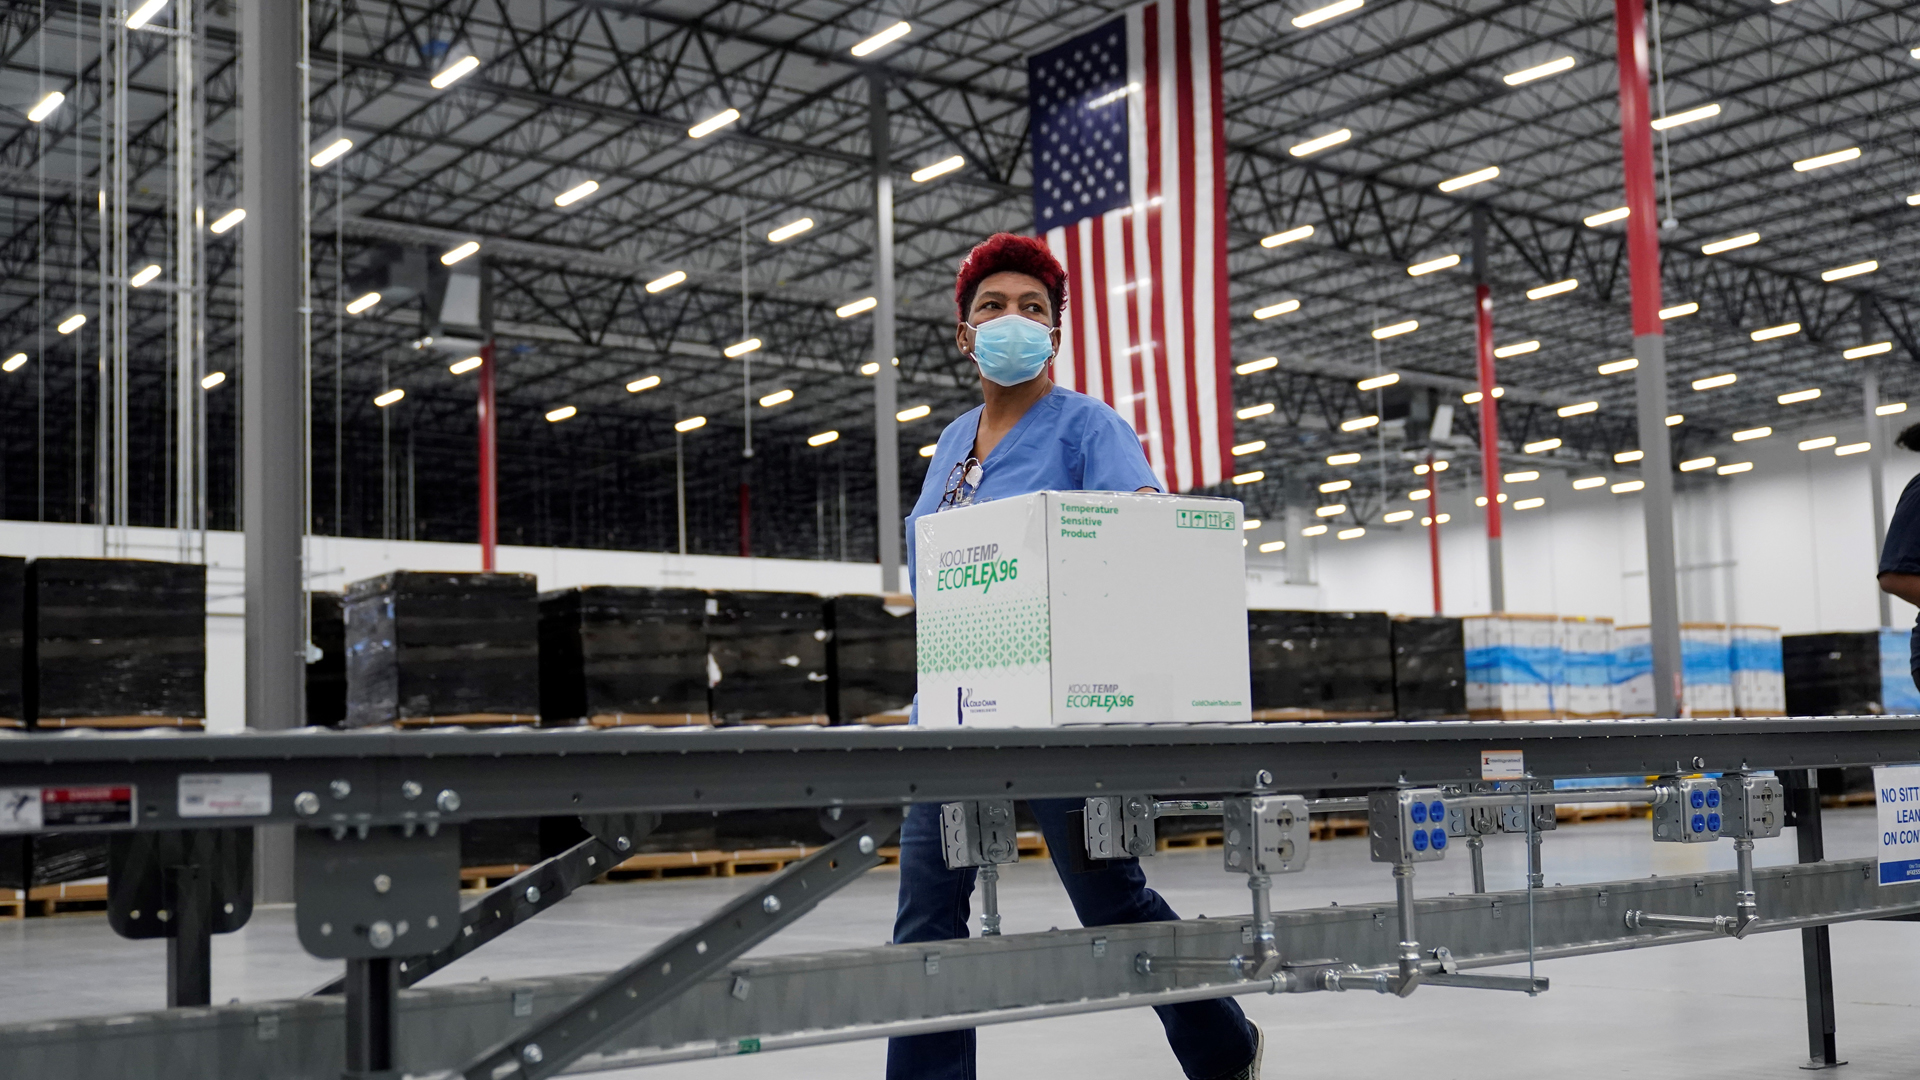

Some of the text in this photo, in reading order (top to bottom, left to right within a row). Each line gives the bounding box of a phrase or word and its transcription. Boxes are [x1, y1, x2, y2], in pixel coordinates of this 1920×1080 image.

[1060, 503, 1119, 514] Temperature
[1060, 516, 1103, 526] Sensitive
[1061, 529, 1097, 538] Product
[939, 543, 999, 568] KOOLTEMP
[1067, 684, 1119, 694] KOOLTEMP
[1881, 788, 1897, 803] NO
[1883, 832, 1897, 846] ON
